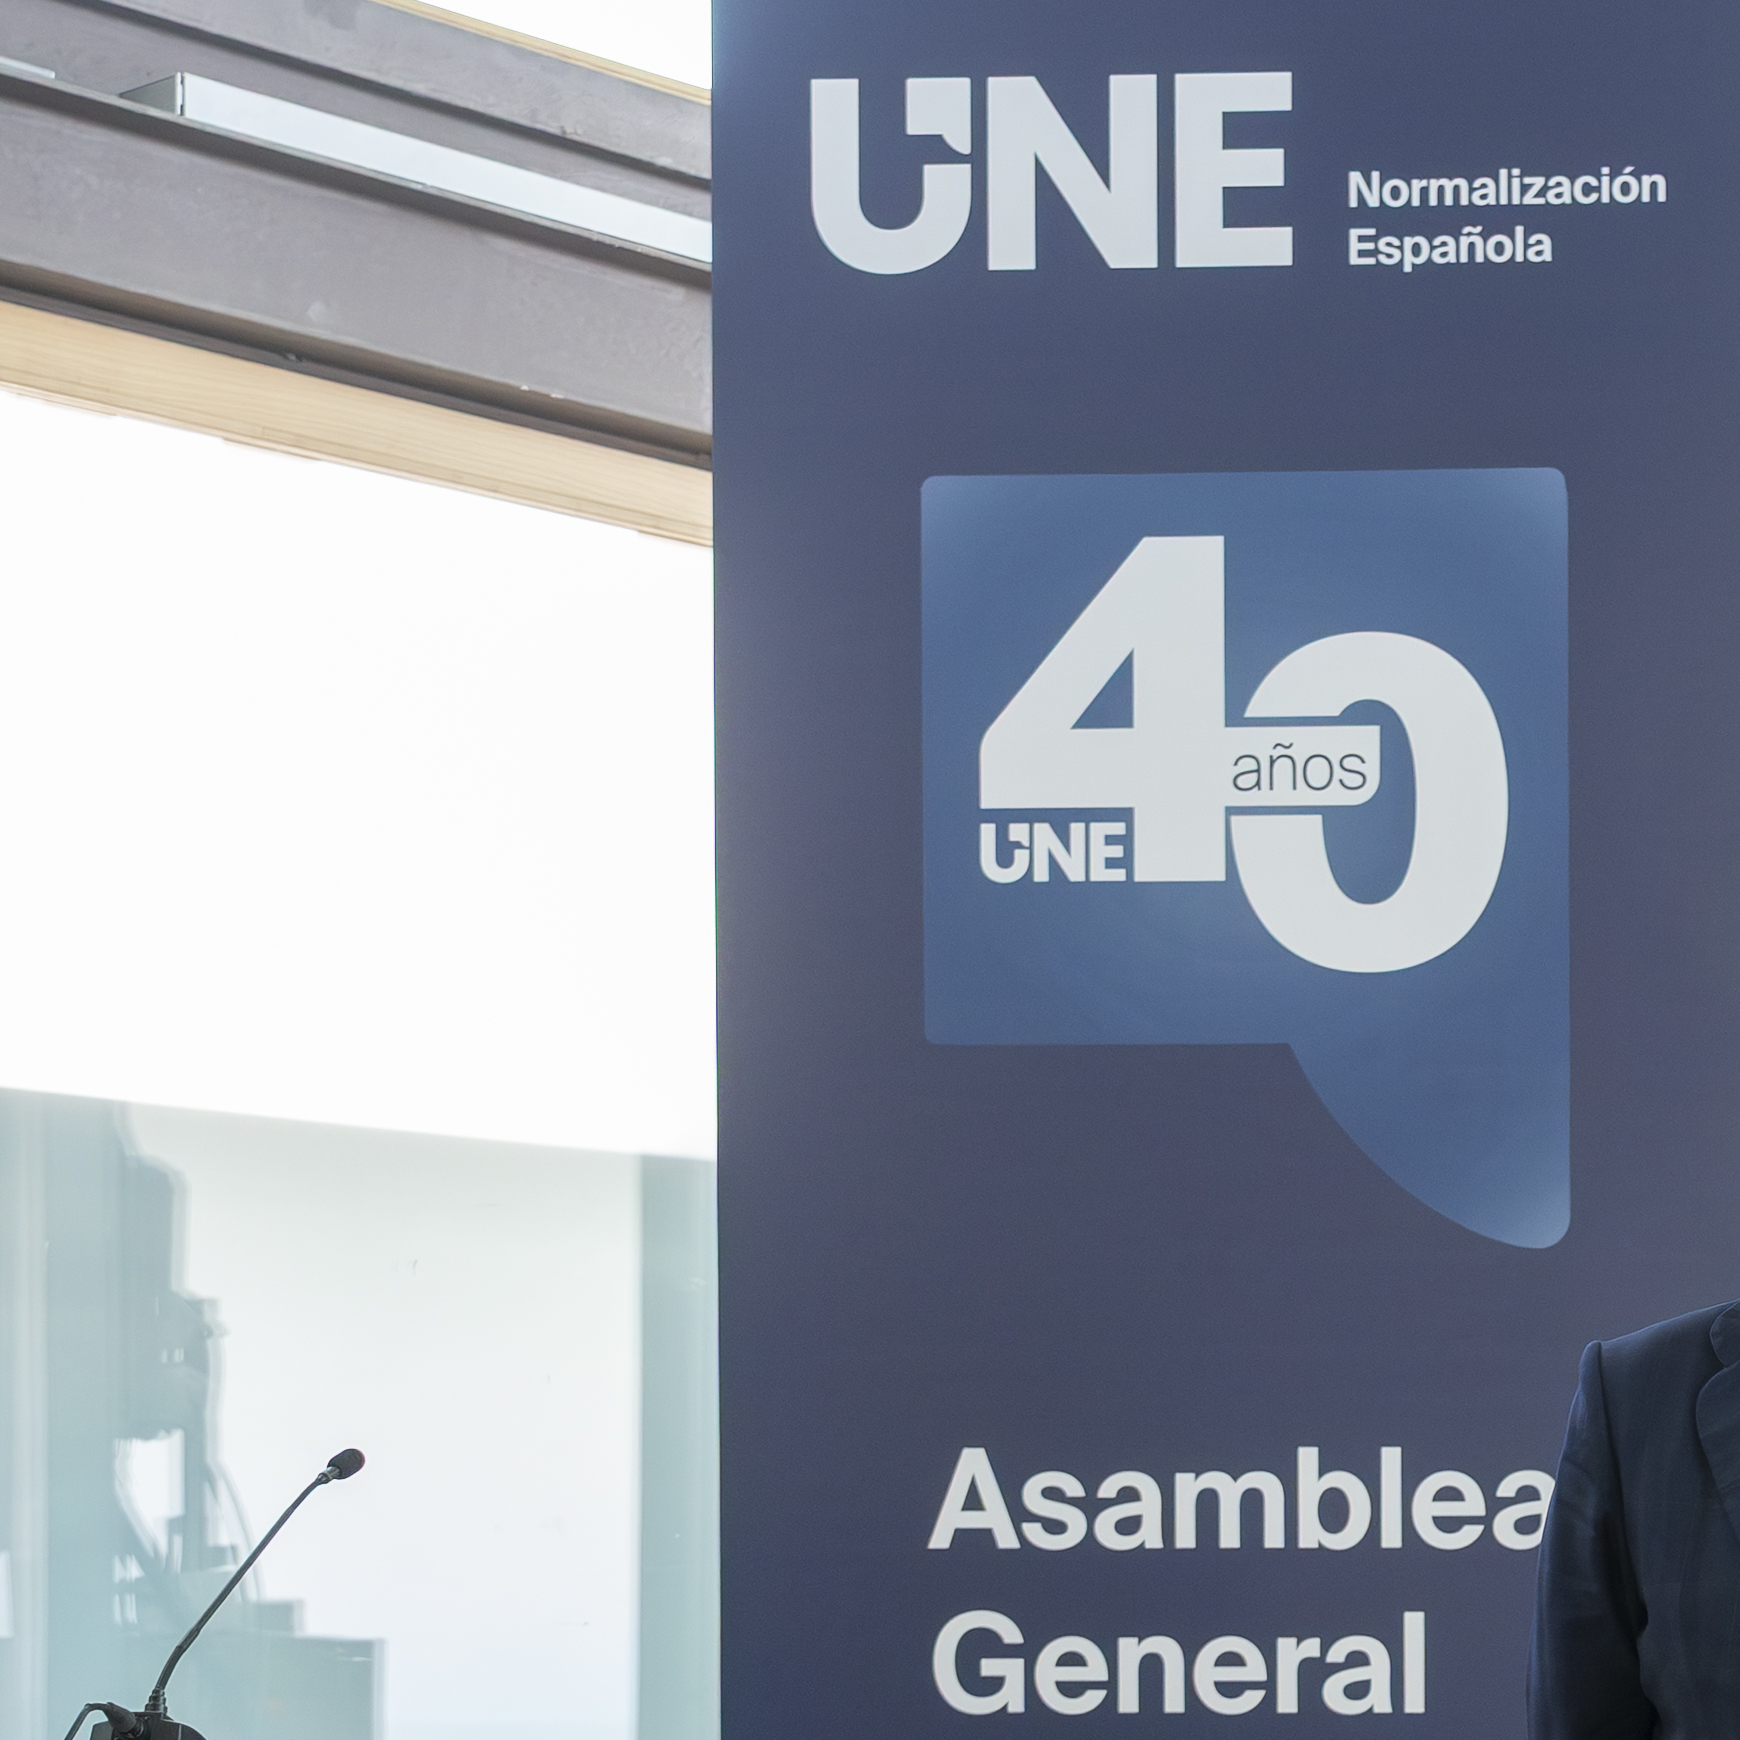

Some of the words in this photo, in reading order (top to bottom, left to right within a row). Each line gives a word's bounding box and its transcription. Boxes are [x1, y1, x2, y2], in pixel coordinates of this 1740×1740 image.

[810, 71, 1293, 275] UNE
[1348, 165, 1667, 208] Normalización
[1348, 225, 1553, 273] Española
[979, 535, 1509, 973] 40
[1232, 742, 1367, 792] años
[979, 821, 1127, 884] UNE
[927, 1446, 1556, 1551] Asamblea
[932, 1609, 1426, 1716] General
